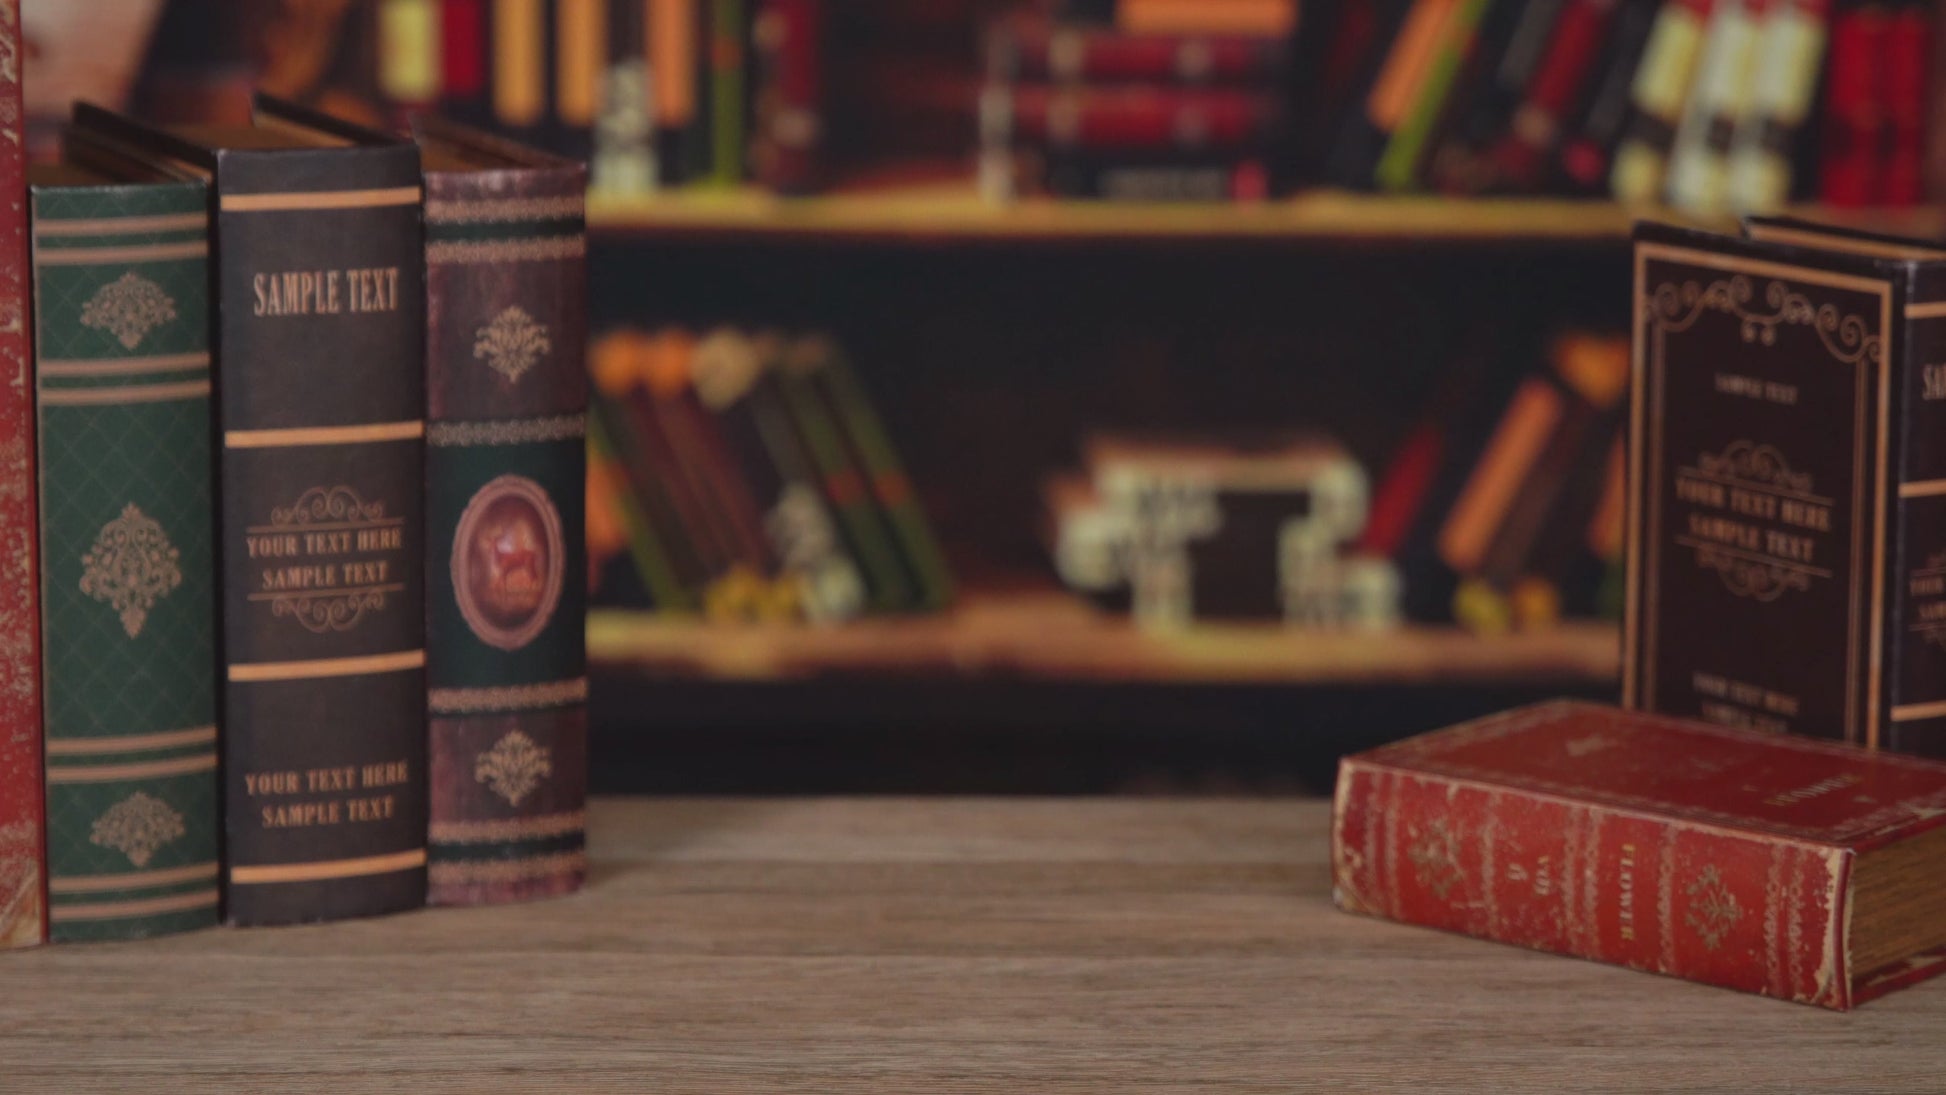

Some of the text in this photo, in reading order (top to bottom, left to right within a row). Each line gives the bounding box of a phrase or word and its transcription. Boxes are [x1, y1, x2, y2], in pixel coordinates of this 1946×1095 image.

[253, 266, 399, 317] SAMPLE TEXT
[1729, 488, 1777, 520] TEXT
[246, 527, 401, 558] YOUR TEXT HERE
[1688, 511, 1814, 563] SAMPLE TEXT
[262, 560, 388, 590] SAMPLE TEXT
[245, 760, 408, 796] YOUR TEXT HERE
[261, 795, 395, 829] SAMPLE TEXT
